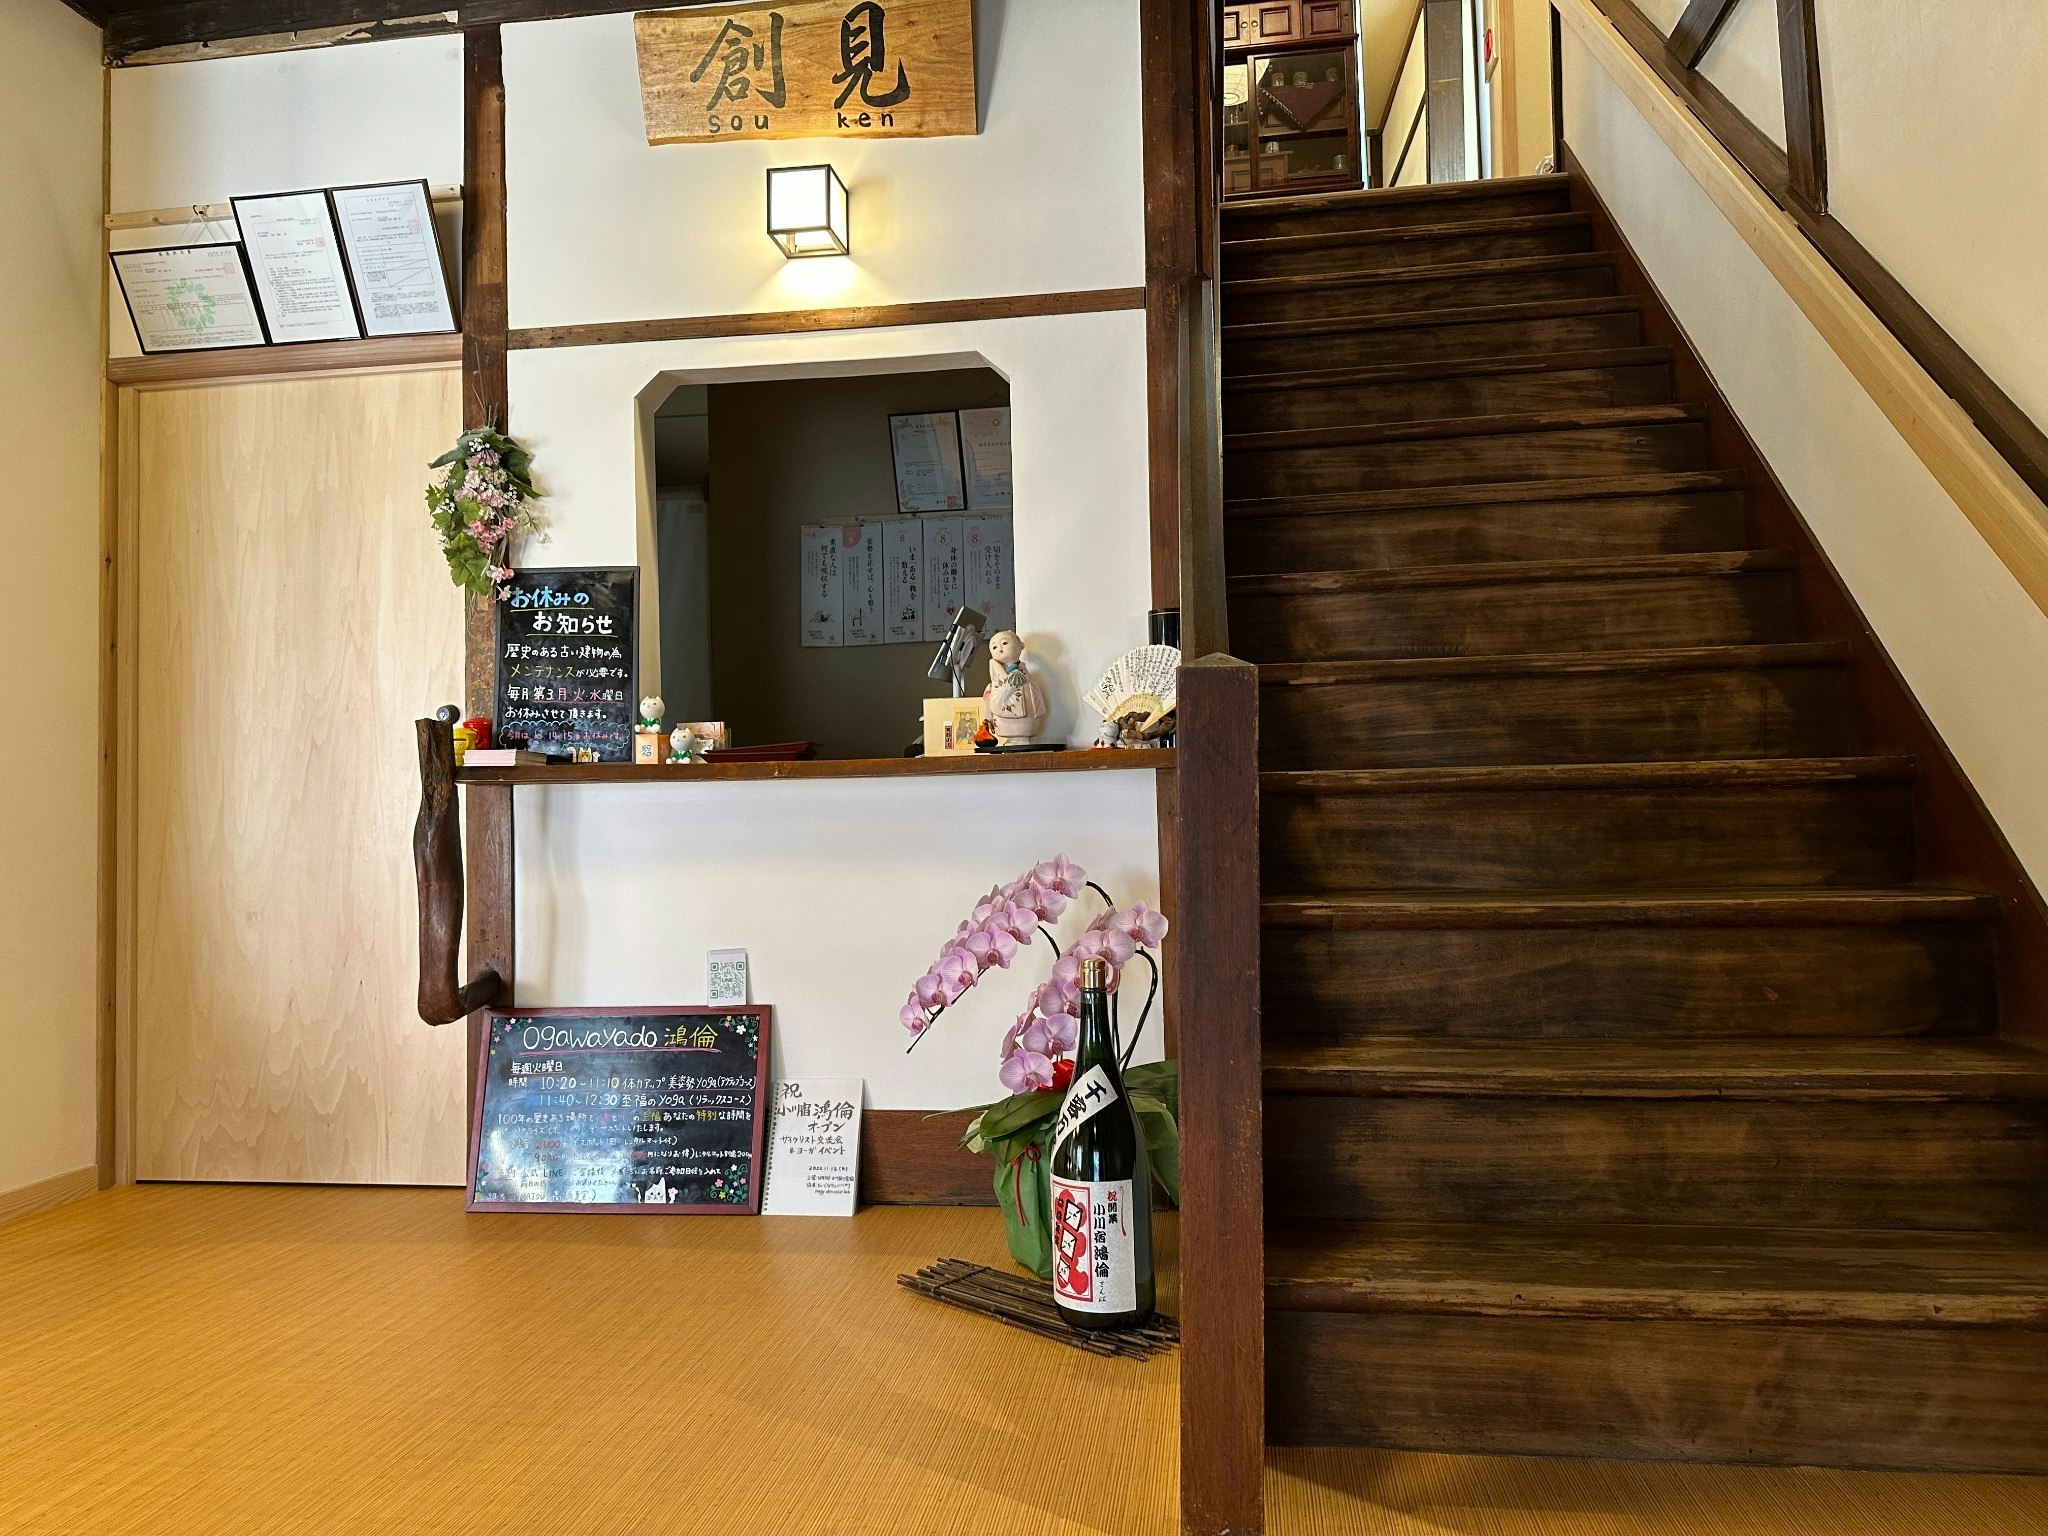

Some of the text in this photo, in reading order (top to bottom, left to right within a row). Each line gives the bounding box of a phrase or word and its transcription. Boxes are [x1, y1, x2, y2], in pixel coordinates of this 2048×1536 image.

[709, 111, 895, 133] sou ken
[940, 533, 946, 543] 8
[971, 533, 978, 543] 8
[510, 586, 590, 608] お休みの
[532, 611, 613, 635] お知らせ
[522, 1025, 658, 1051] Ogawayado
[511, 1060, 563, 1075] 毎週火曜日
[508, 1077, 528, 1089] 時間
[780, 1082, 803, 1099] 祝
[807, 1120, 846, 1134] オープン
